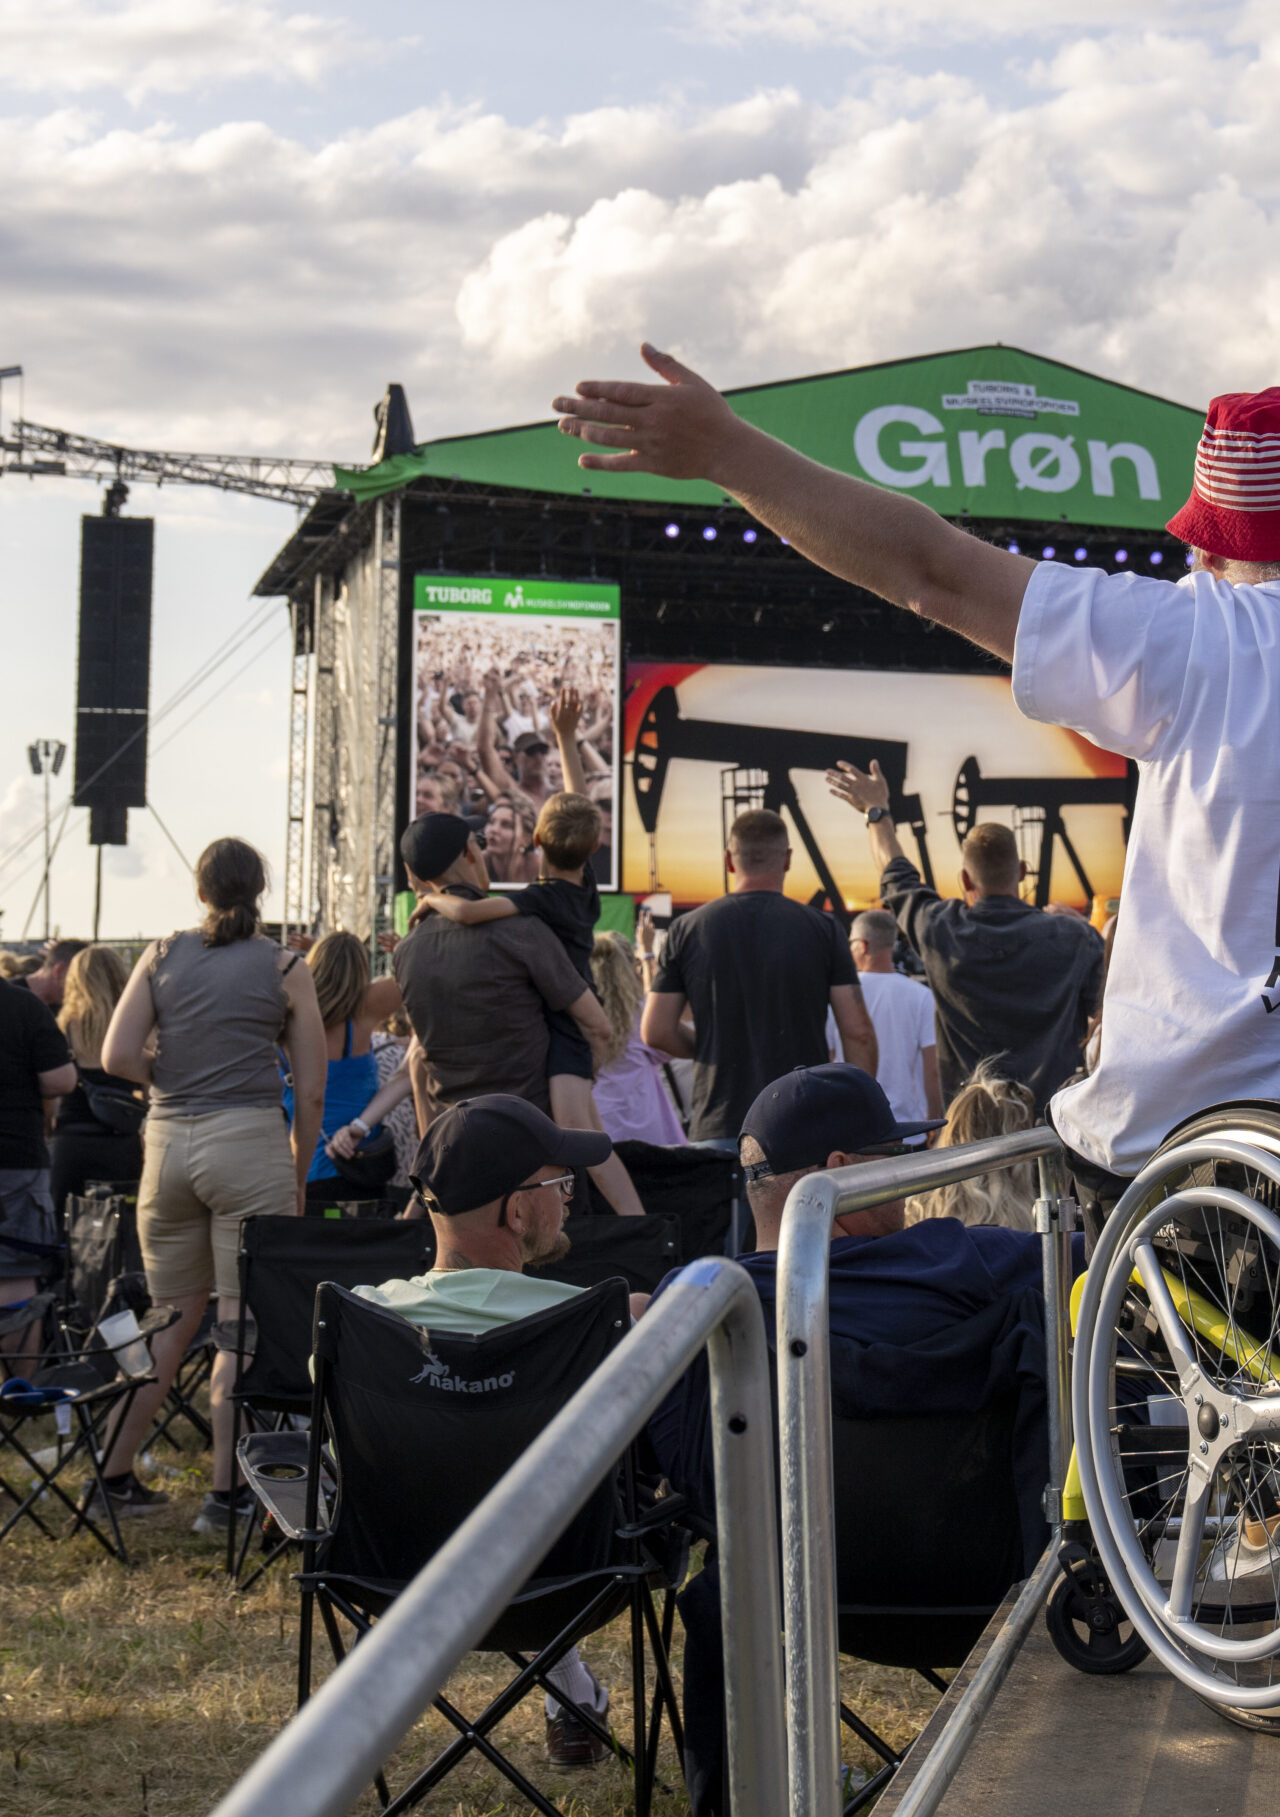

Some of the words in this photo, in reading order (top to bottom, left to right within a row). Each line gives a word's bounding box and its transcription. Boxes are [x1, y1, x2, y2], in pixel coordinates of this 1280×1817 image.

[853, 404, 1162, 501] Grøn
[425, 585, 493, 605] TUBORG
[429, 1372, 514, 1393] nakano
